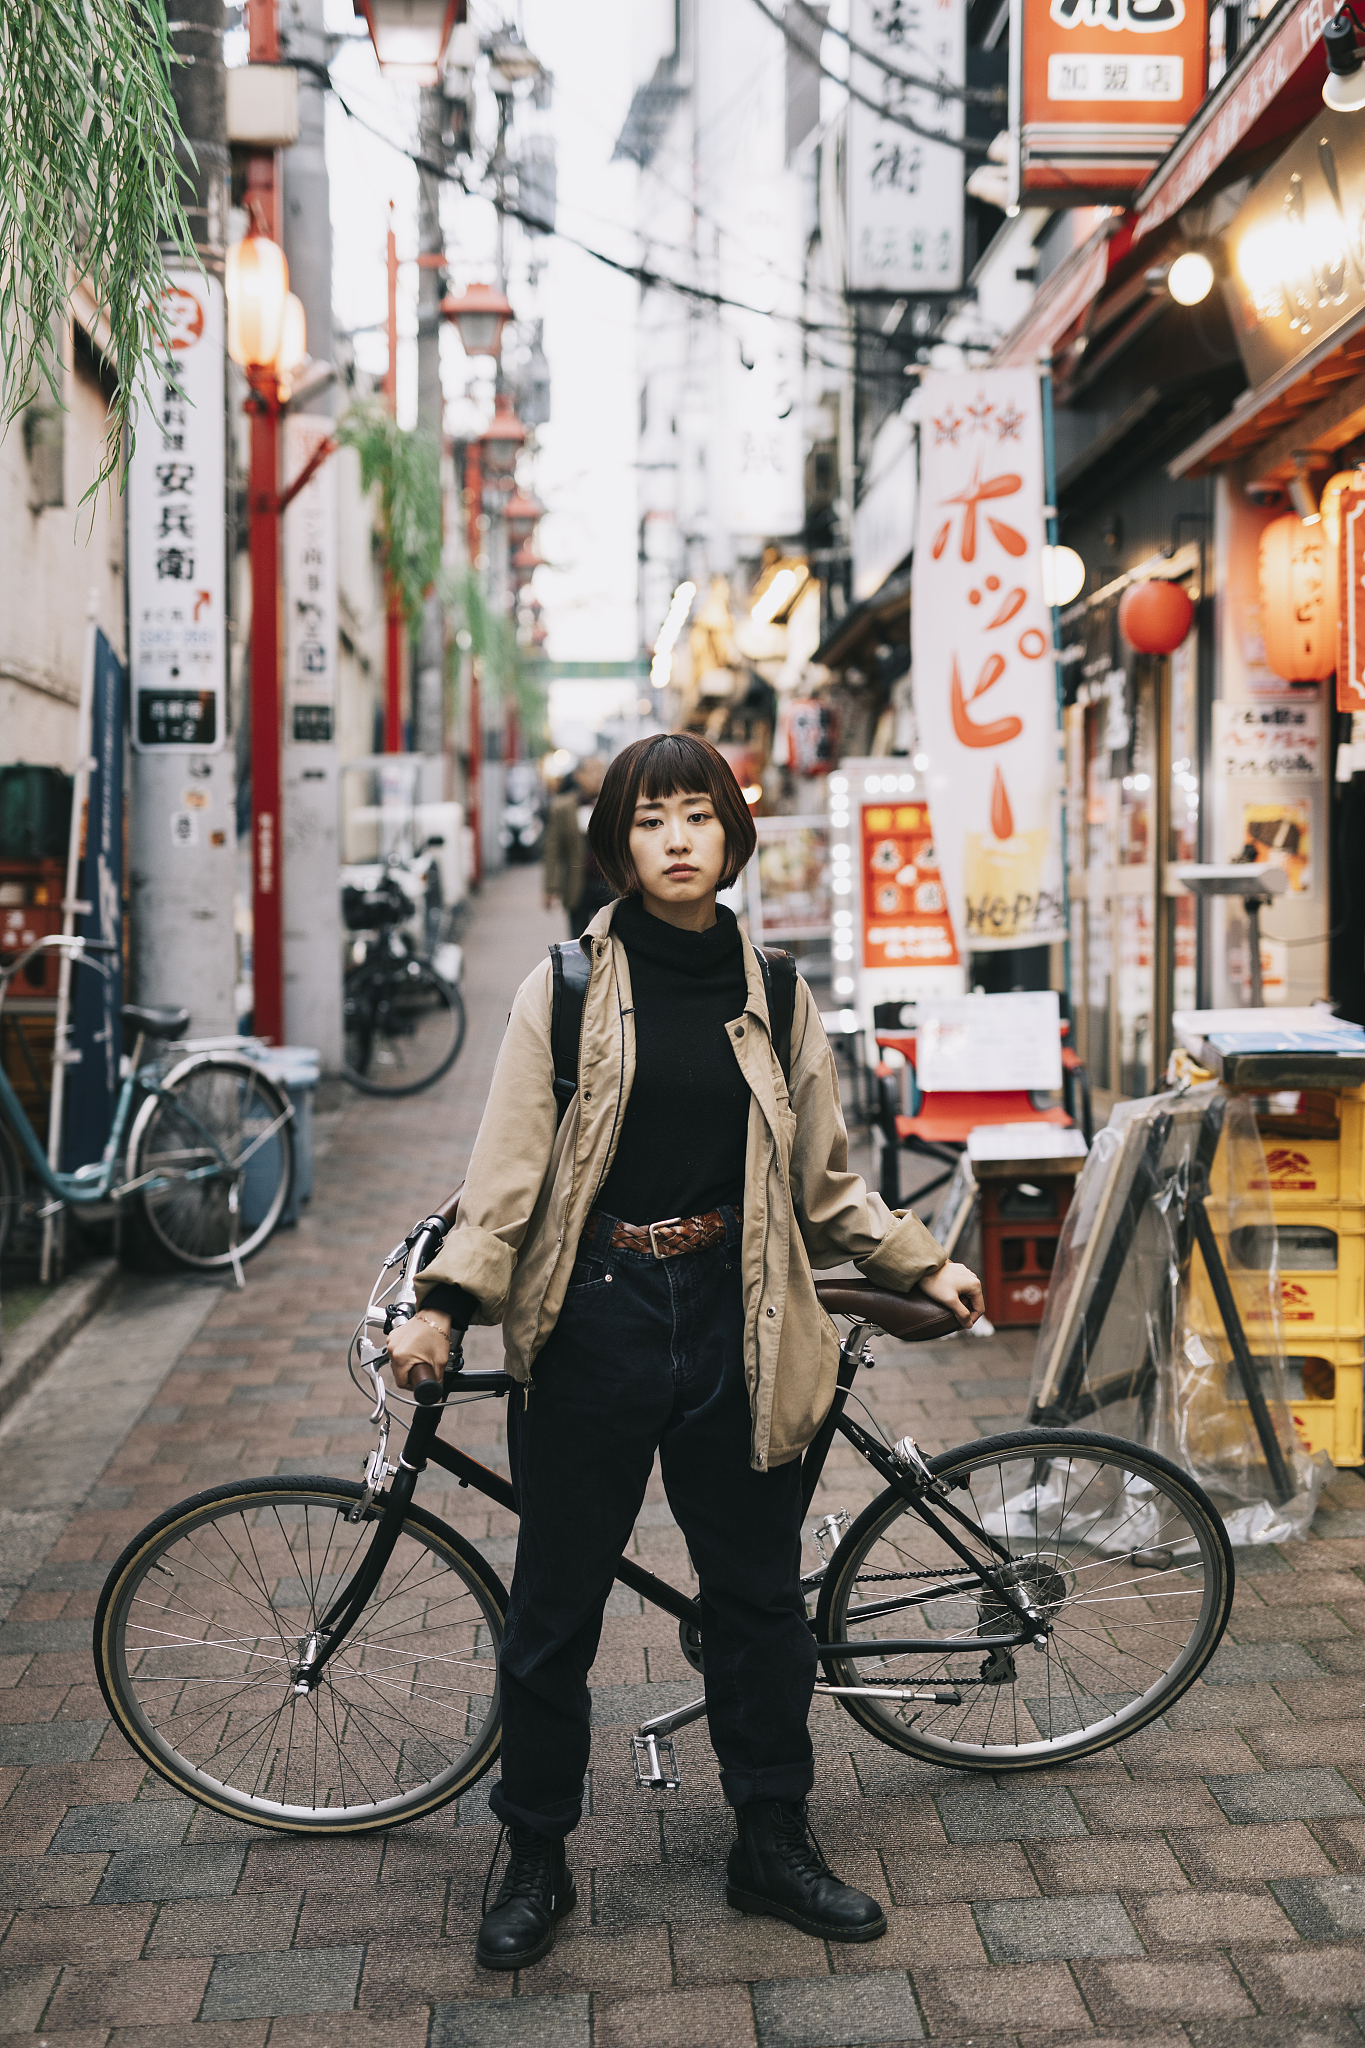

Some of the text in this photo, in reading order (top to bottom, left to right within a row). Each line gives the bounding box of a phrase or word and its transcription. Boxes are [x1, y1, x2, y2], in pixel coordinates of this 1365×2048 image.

[1060, 64, 1172, 93] 加盟店
[156, 463, 194, 579] 安兵衛
[930, 447, 1047, 839] ホッピー
